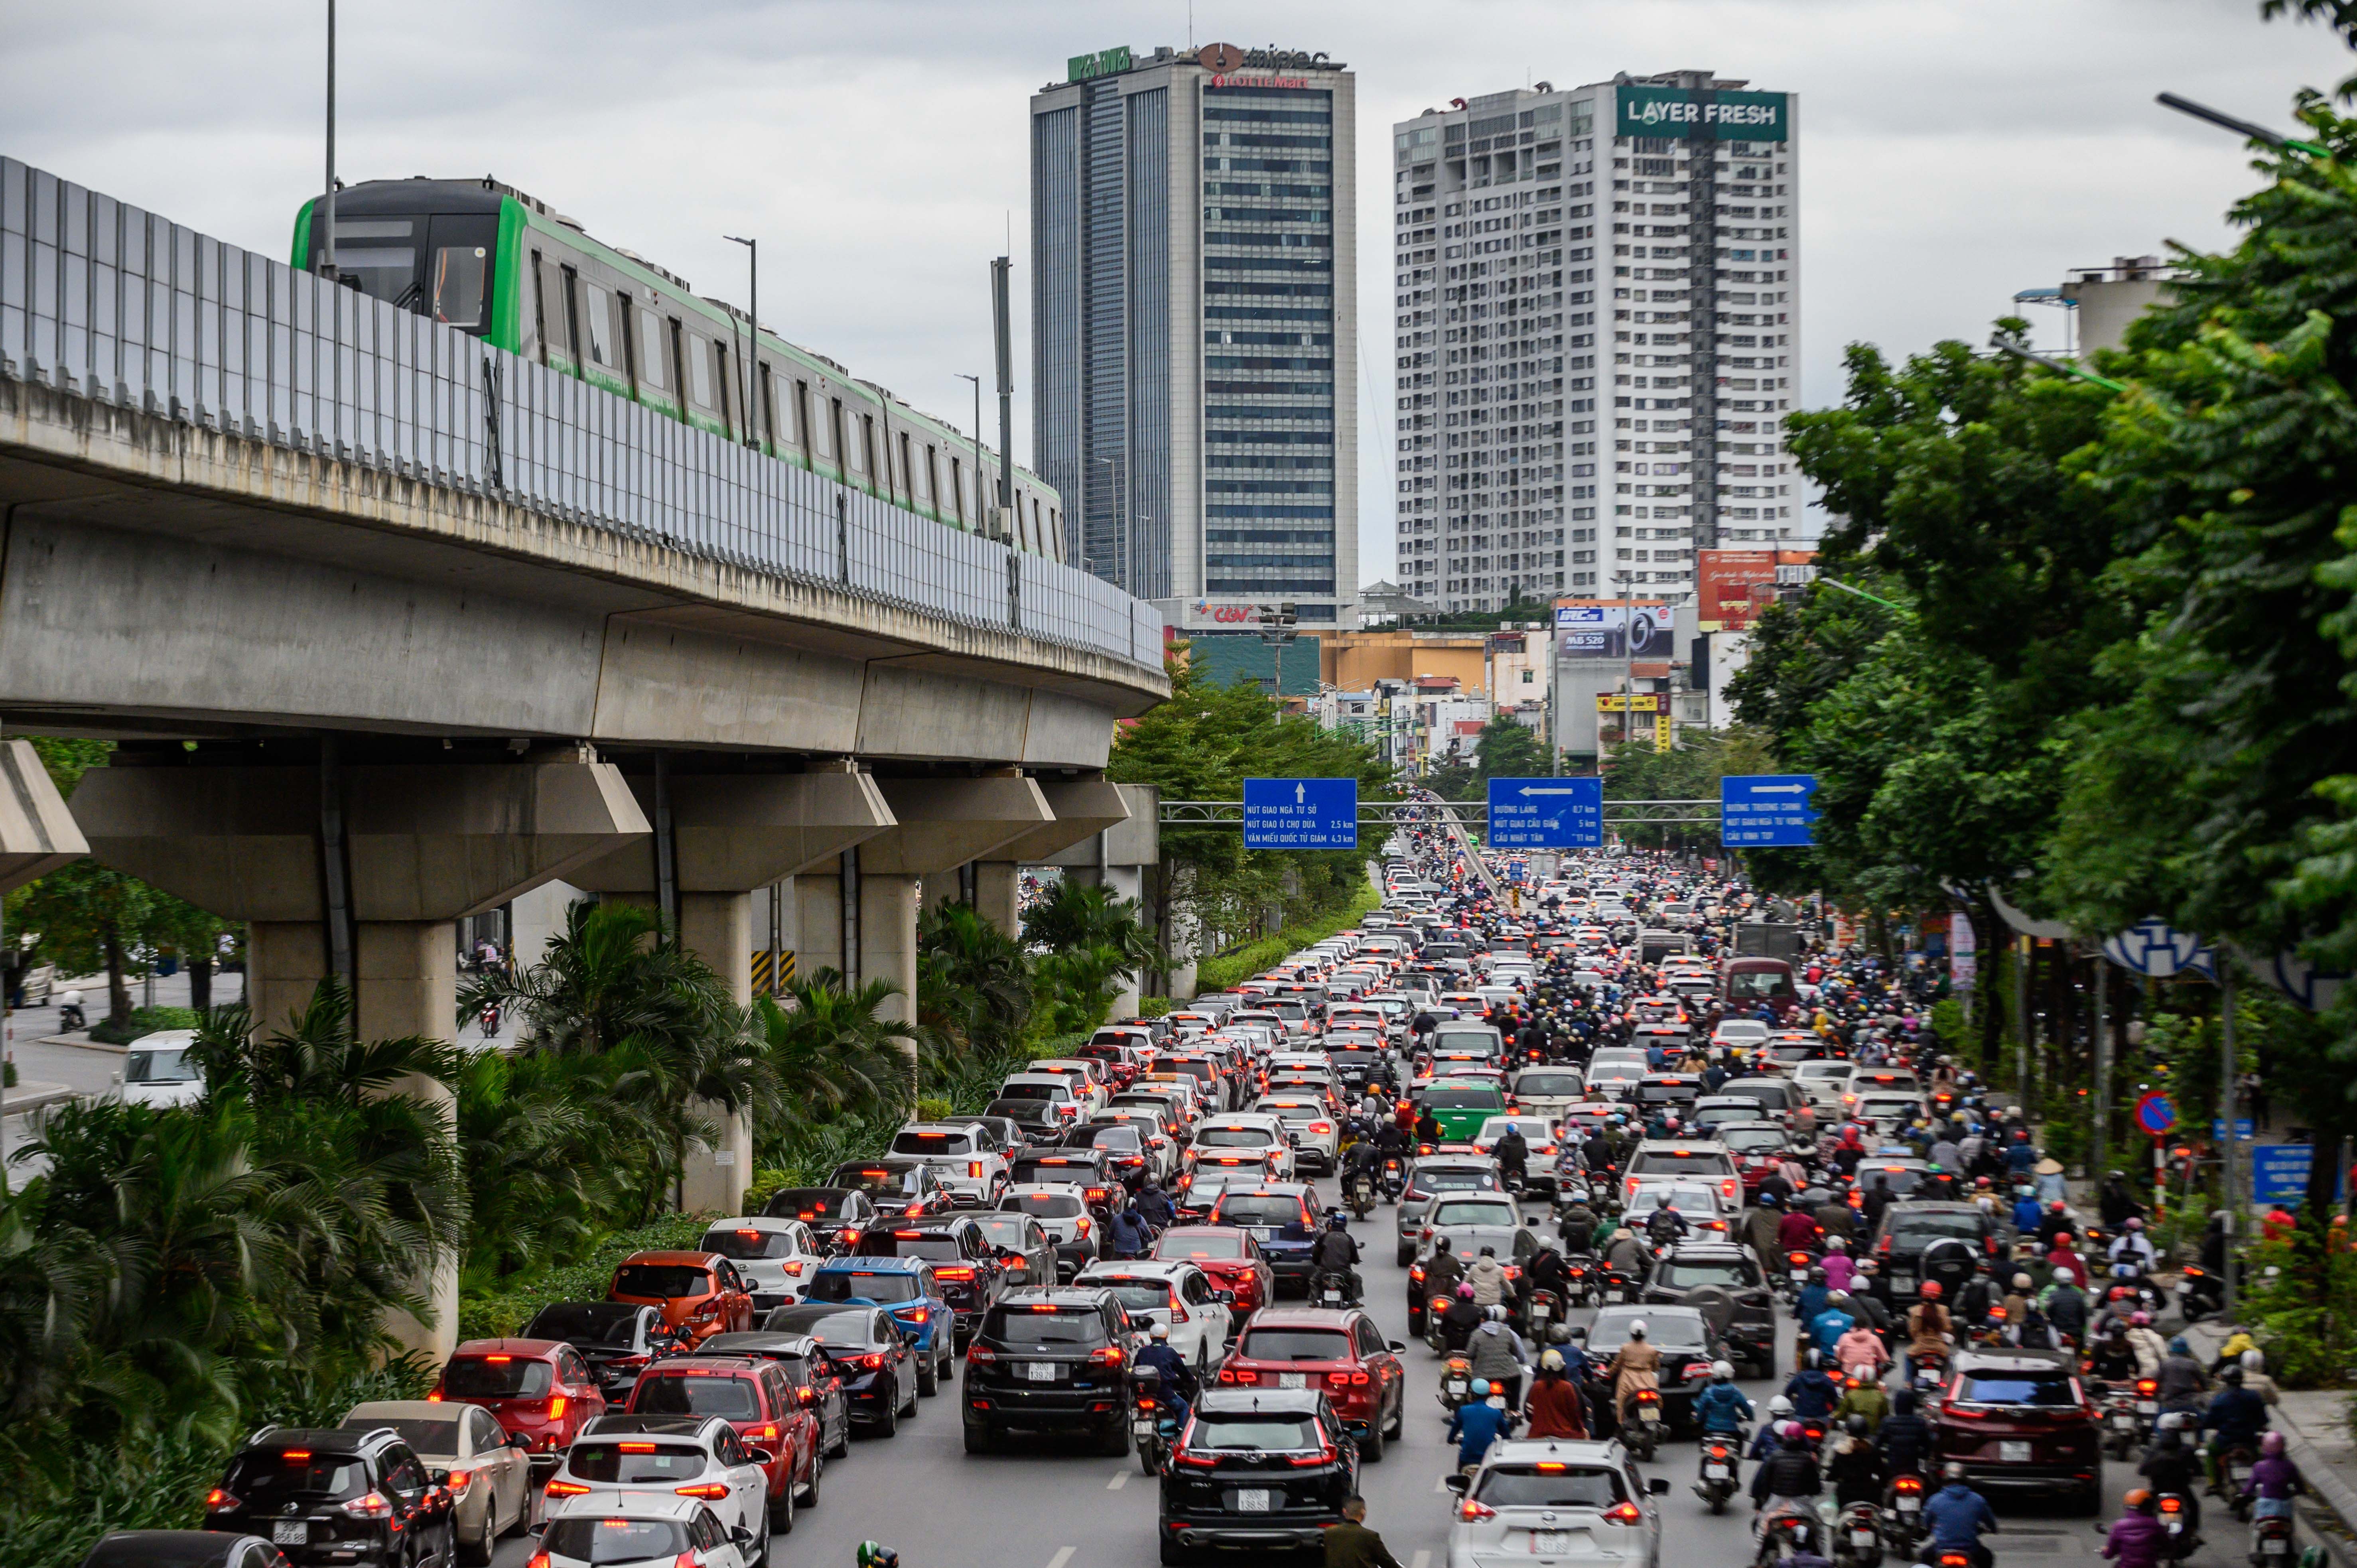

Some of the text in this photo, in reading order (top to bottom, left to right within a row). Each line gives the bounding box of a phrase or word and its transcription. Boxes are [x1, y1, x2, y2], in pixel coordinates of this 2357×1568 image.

[1098, 45, 1130, 75] TOWER
[1229, 76, 1309, 89] LOTTE Mart
[1628, 101, 1776, 125] LAYER FRESH
[1214, 607, 1249, 622] CGV
[1247, 804, 1259, 814] NÚT
[1280, 804, 1293, 814] NGÃ
[1296, 806, 1305, 814] TƯ
[1308, 804, 1317, 814] SỞ
[1247, 818, 1259, 828] NÚT
[1280, 819, 1284, 828] Ô
[1287, 820, 1300, 829] CHỢ
[1303, 818, 1316, 828] DỪA
[1527, 817, 1541, 827] CẦU
[1247, 833, 1260, 842] VĂN
[1263, 832, 1278, 842] MIẾU
[1280, 832, 1297, 842] QUỐC
[1300, 832, 1308, 842] TỬ
[1310, 832, 1326, 842] GIÁM
[1494, 832, 1508, 842] CẦU
[1531, 833, 1544, 842] TÂN
